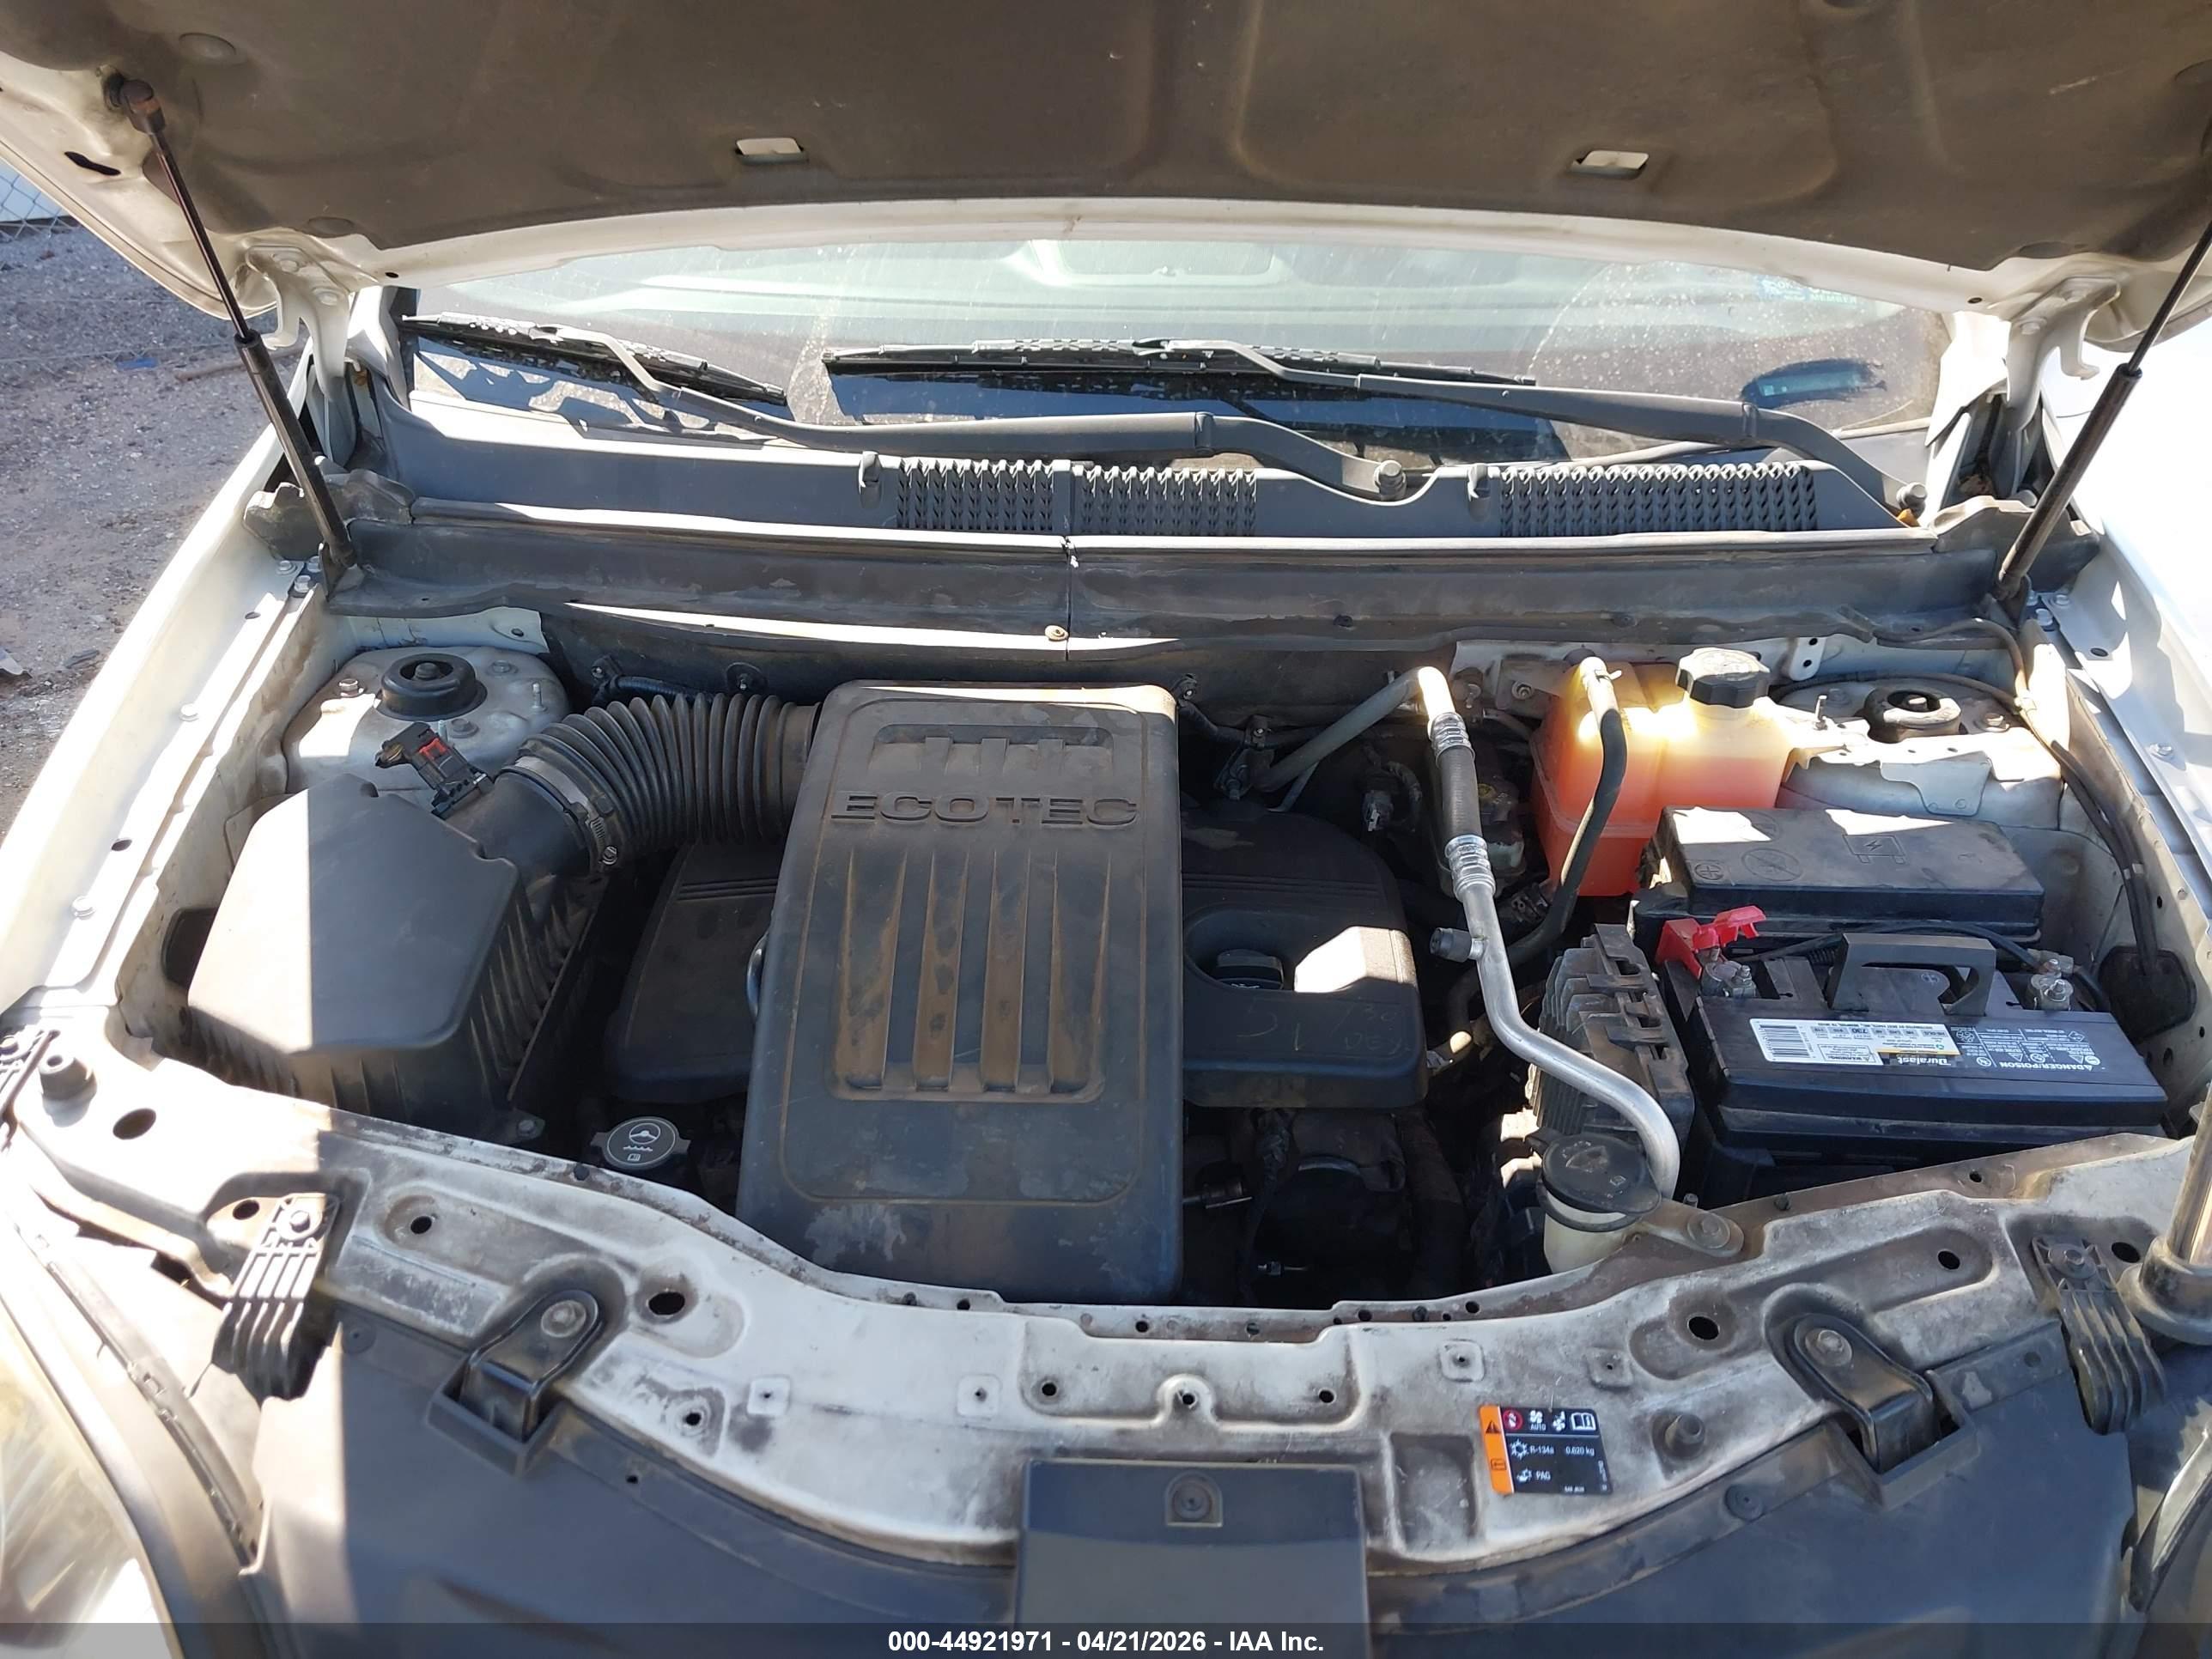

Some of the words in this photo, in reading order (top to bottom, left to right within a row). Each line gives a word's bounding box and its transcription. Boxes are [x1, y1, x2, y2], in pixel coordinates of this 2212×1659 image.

[831, 792, 1137, 826] ECOTEC
[1897, 1055, 1951, 1066] Duralast
[1999, 1061, 2086, 1071] DANGER/POISON
[1530, 1423, 1547, 1431] AUTO
[1585, 1446, 1595, 1457] kg
[1535, 1471, 1552, 1481] PAG
